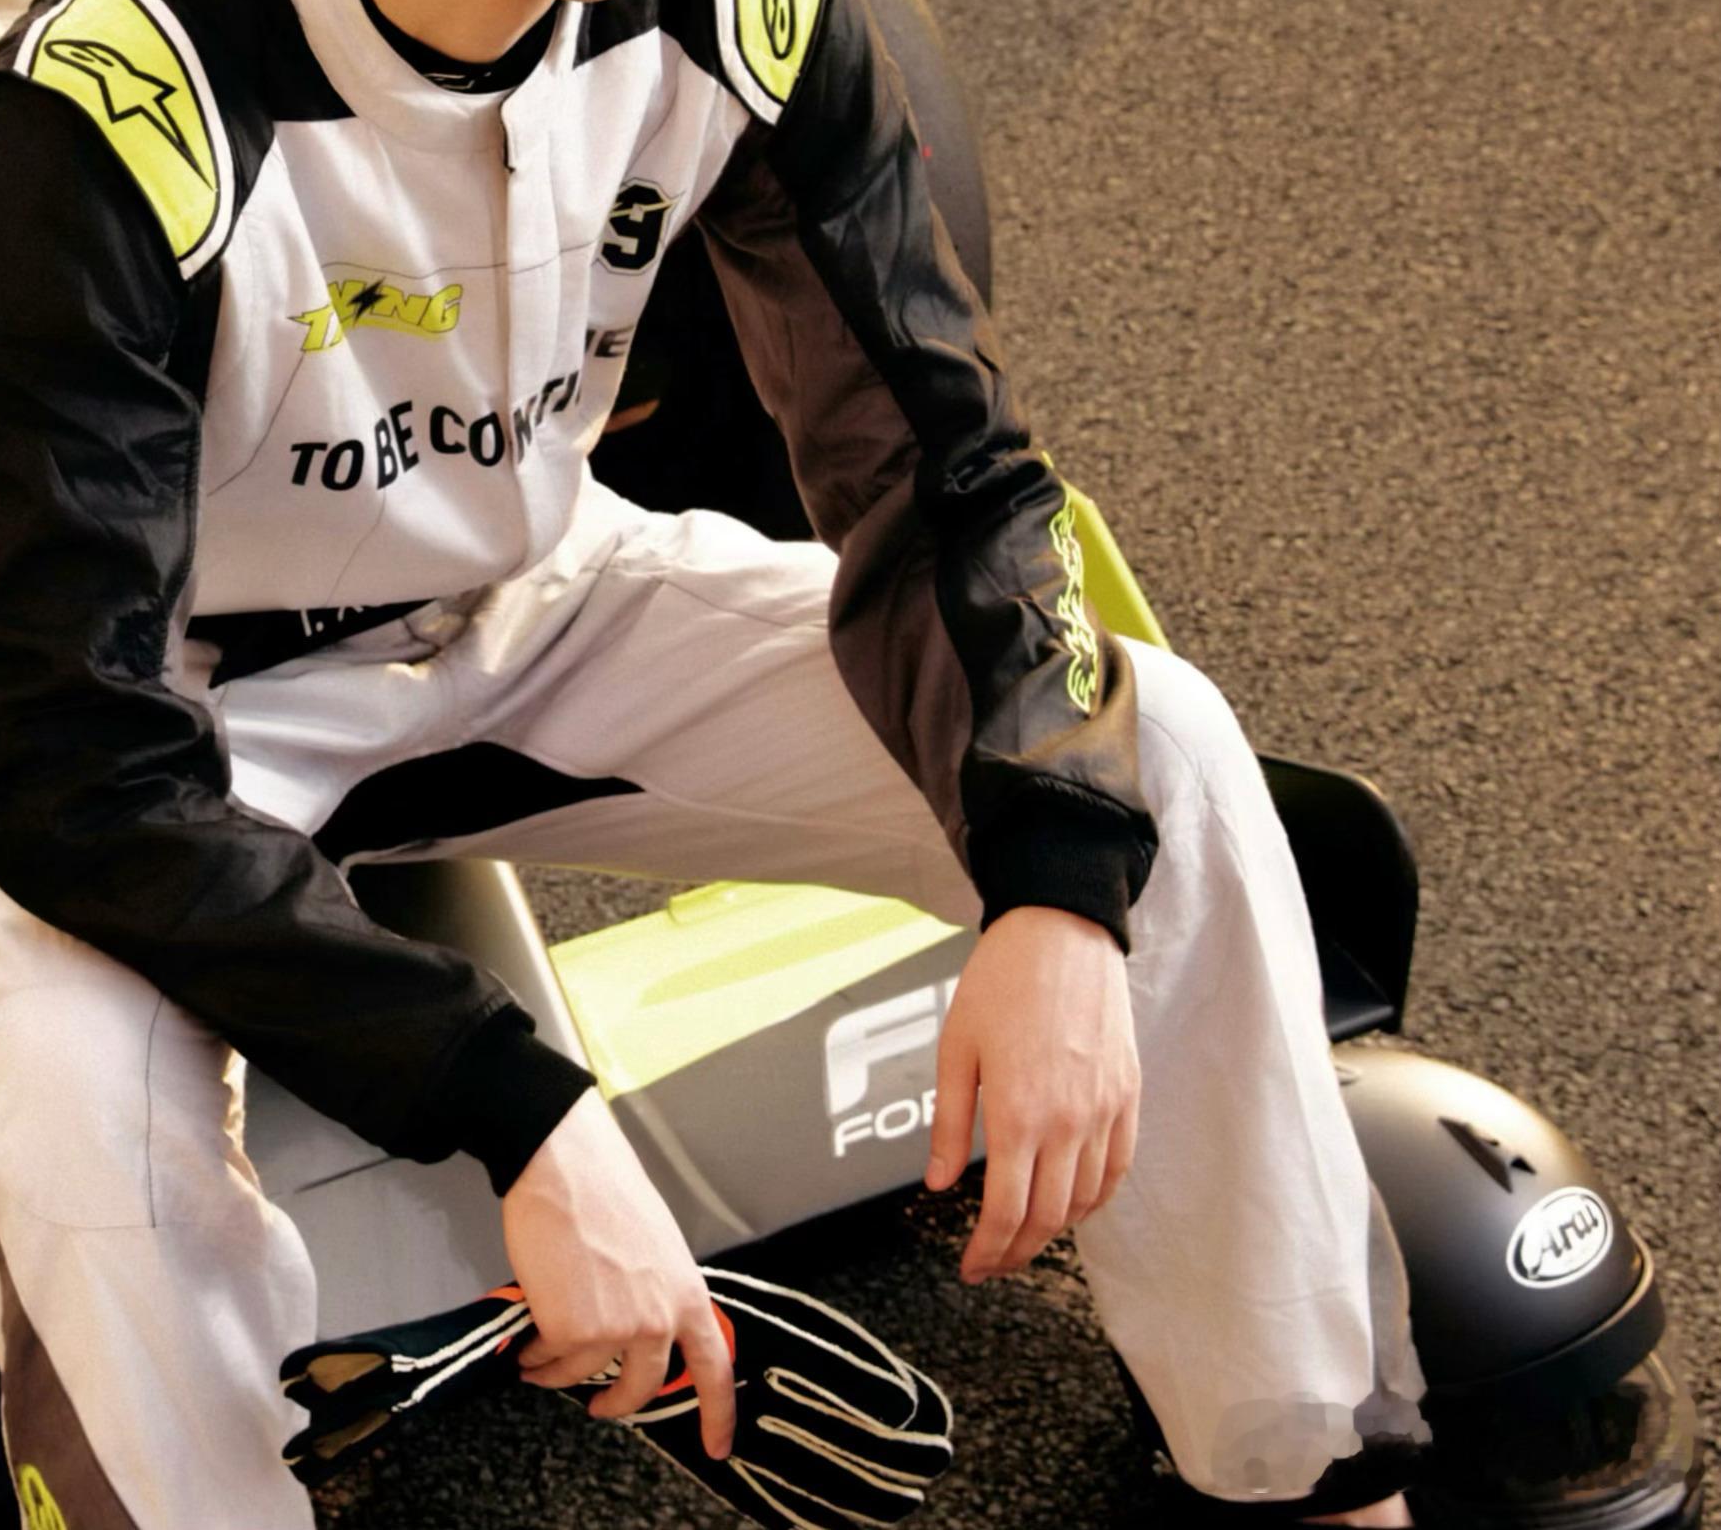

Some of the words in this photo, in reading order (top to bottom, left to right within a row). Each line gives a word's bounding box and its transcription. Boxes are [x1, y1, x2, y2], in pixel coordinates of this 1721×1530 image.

[598, 179, 671, 275] 9
[290, 439, 365, 492] TO
[375, 401, 419, 489] BE
[824, 975, 961, 1116] F
